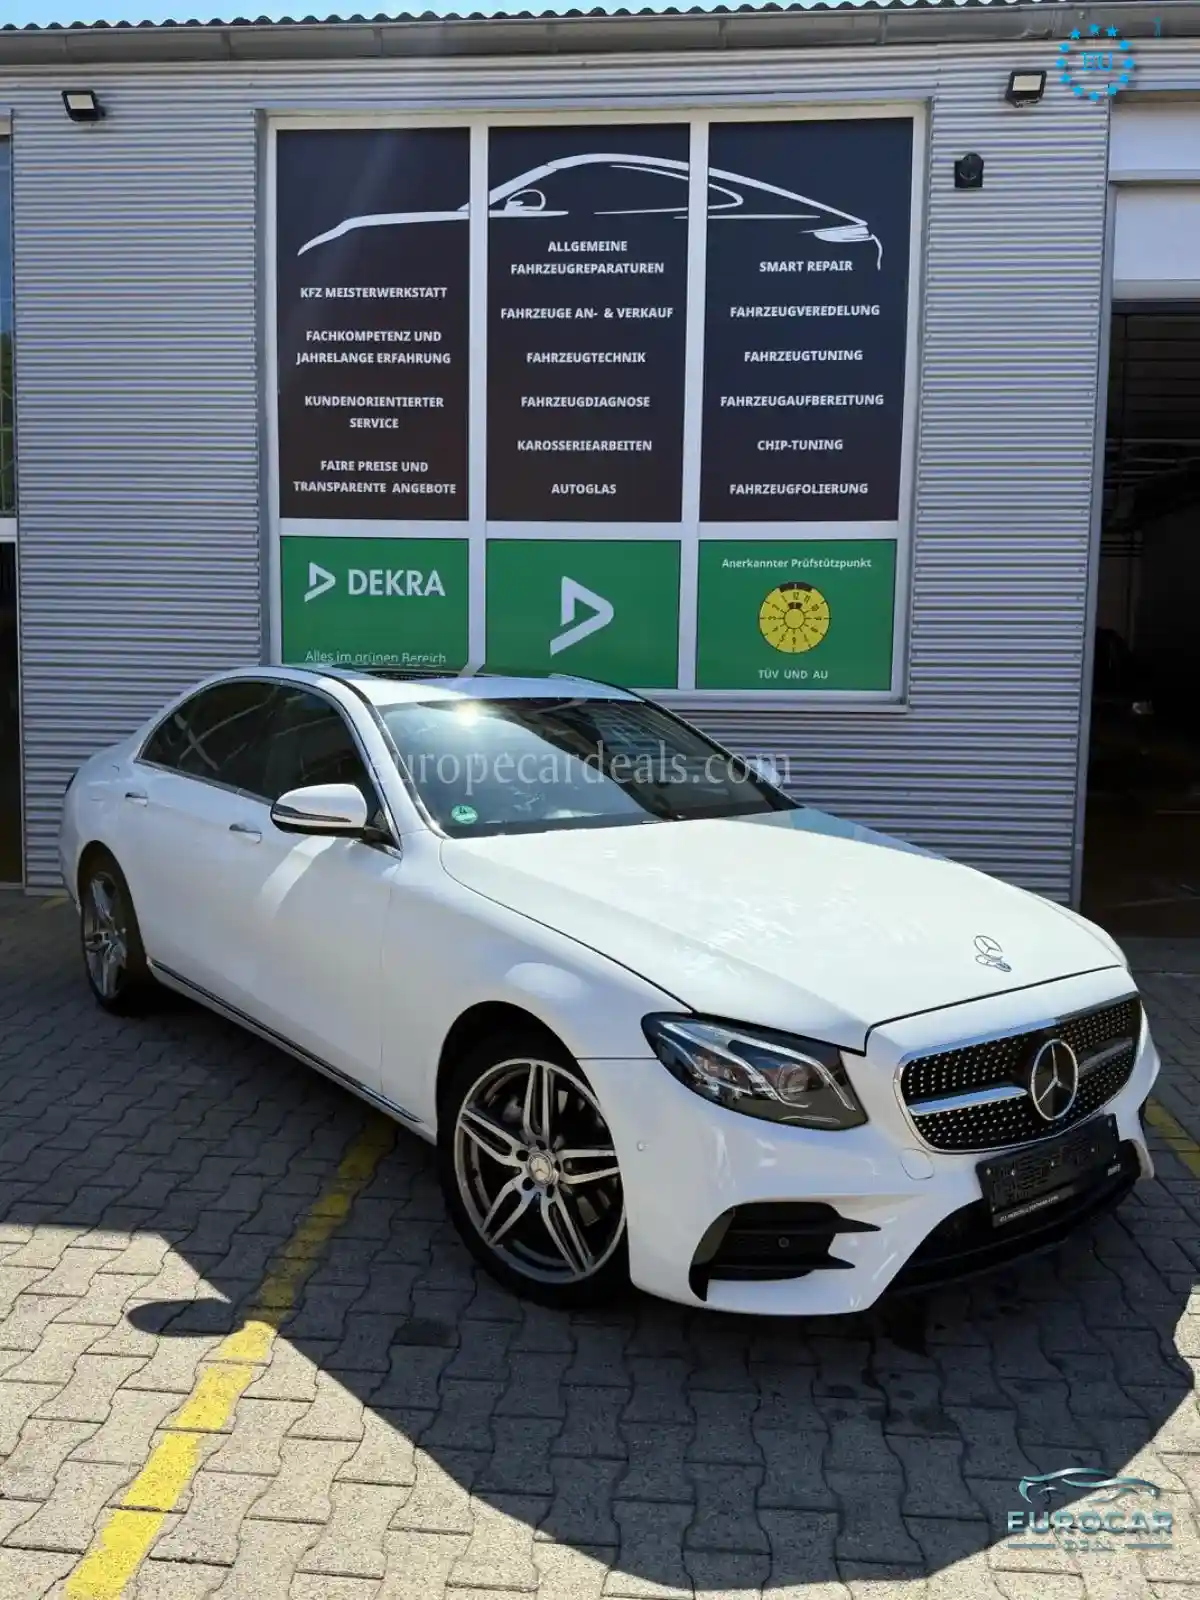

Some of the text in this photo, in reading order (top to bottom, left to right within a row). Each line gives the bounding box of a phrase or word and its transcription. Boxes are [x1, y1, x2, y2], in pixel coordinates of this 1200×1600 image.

[547, 240, 627, 252] ALLGEMEINE
[510, 262, 663, 274] FAHRZEUGREPARATUREN
[759, 260, 852, 272] SMART REPAIR
[300, 287, 447, 298] KFZ MEISTERWERKSTATT
[500, 307, 673, 319] FAHRZEUGE AN- & VERKAUF
[730, 304, 879, 317] FAHRZEUGVEREDELUNG
[306, 330, 441, 342] FACHKOMPETENZ UND
[296, 352, 450, 364] JAHRELANGE ERFAHRUNG
[526, 352, 645, 363] FAHRZEUGTECHNIK
[744, 350, 862, 361] FAHRZEUGTUNING
[304, 395, 443, 407] KUNDENORIENTIERTER
[521, 396, 649, 407] FAHRZEUGDIAGNOSE
[720, 394, 883, 406] FAHRZEUGAUFBEREITUNG
[349, 417, 398, 428] SERVICE
[517, 440, 651, 451] KAROSSERIEARBEITEN
[757, 439, 842, 450] CHIP-TUNING
[320, 460, 428, 472] FAIRE PREISE UND
[293, 481, 455, 493] TRANSPARENTE ANGEBOTE
[551, 483, 616, 494] AUTOGLAS
[729, 483, 868, 494] FAHRZEUGFOLIERUNG
[722, 558, 871, 569] Anerkannter Prüfstützpunkt
[348, 569, 445, 596] DEKRA
[305, 649, 333, 662] Alles
[336, 650, 352, 662] im
[758, 668, 828, 679] TÜV UND AU
